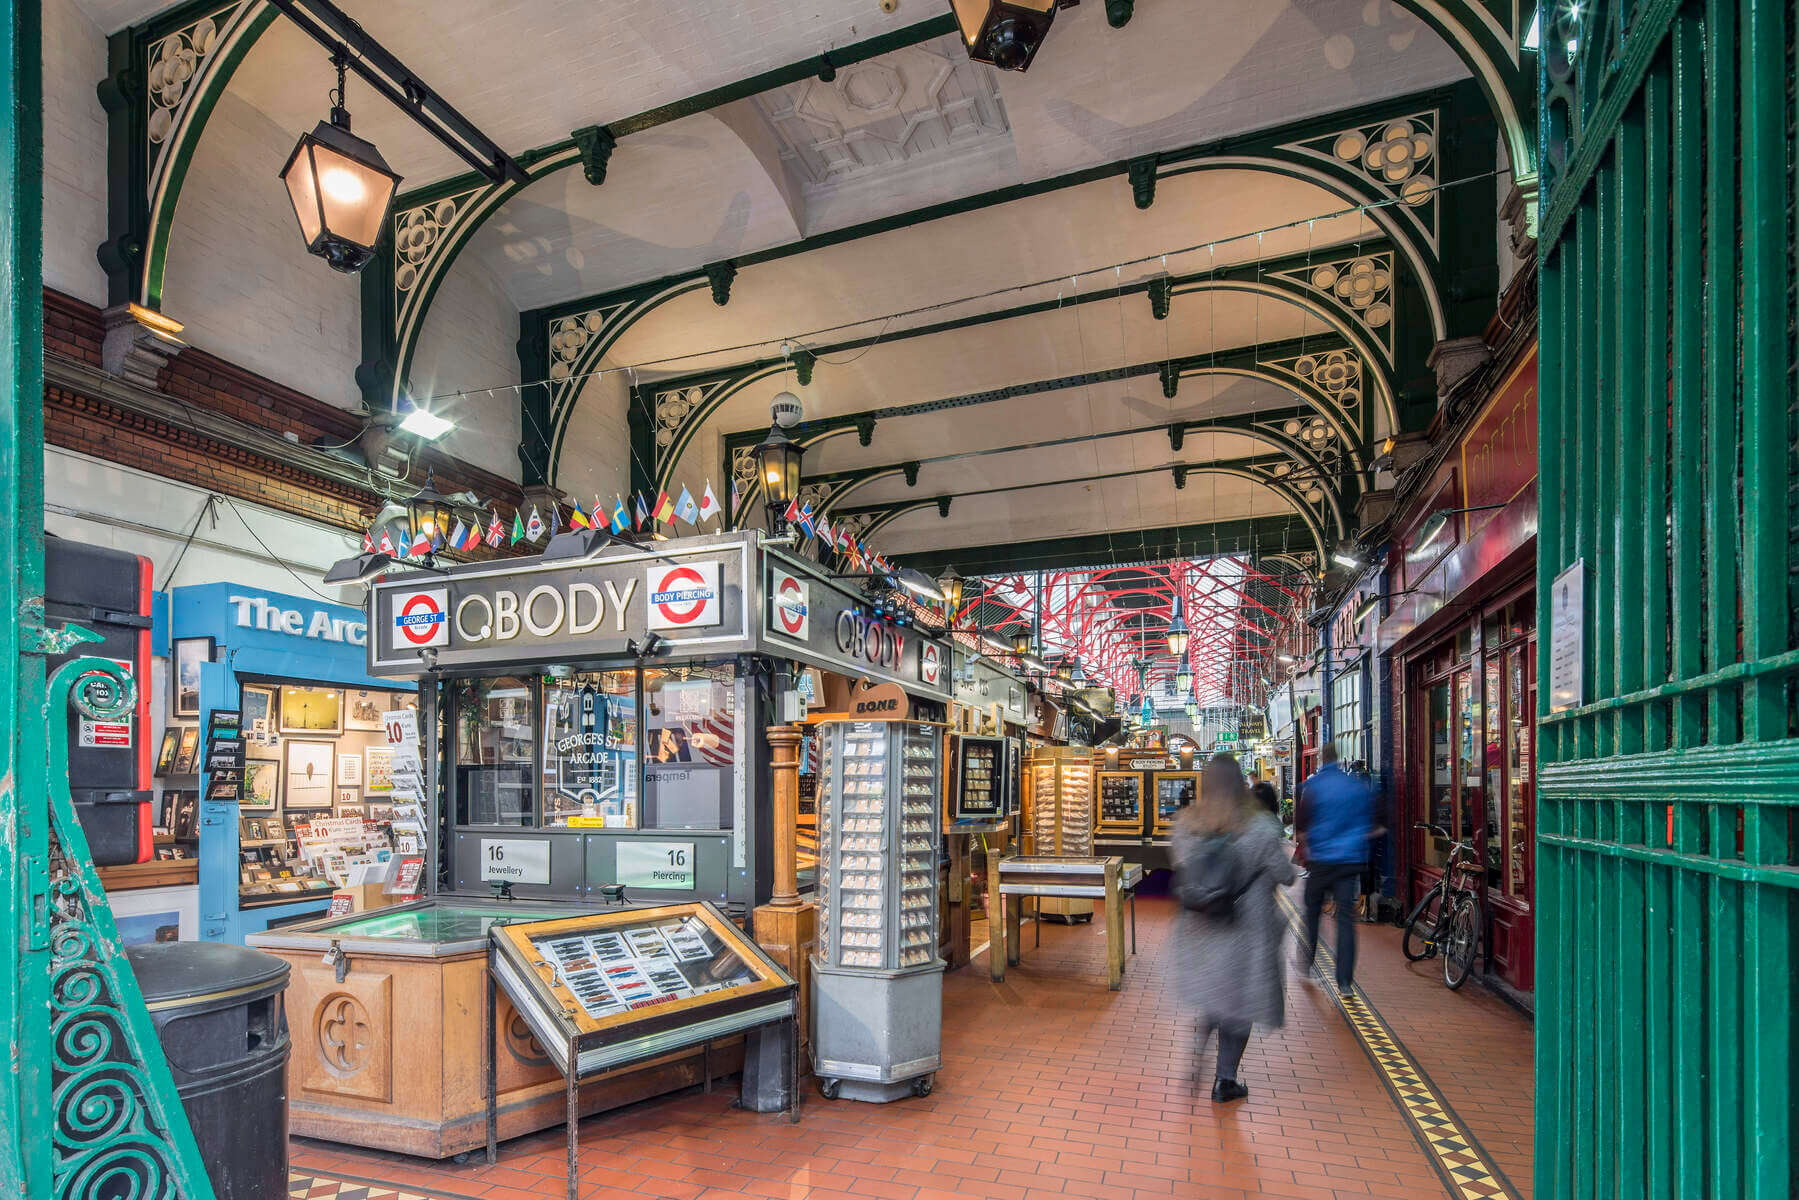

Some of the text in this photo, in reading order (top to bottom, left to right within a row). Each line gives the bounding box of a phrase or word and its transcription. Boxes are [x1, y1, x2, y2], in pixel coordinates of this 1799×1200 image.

[654, 589, 711, 602] BODY PIERCING
[229, 596, 304, 636] The
[456, 577, 639, 642] QBODY
[403, 614, 438, 625] GEORGE ST
[836, 609, 904, 671] QBODY
[856, 699, 897, 713] BONE
[386, 721, 403, 743] 10
[558, 732, 604, 752] GEORGES
[569, 752, 609, 764] ARCADE
[314, 827, 328, 838] 10
[401, 842, 410, 853] 10
[488, 845, 504, 861] 16
[668, 849, 685, 866] 16
[488, 865, 523, 876] Jewellery
[653, 871, 686, 882] Piercing
